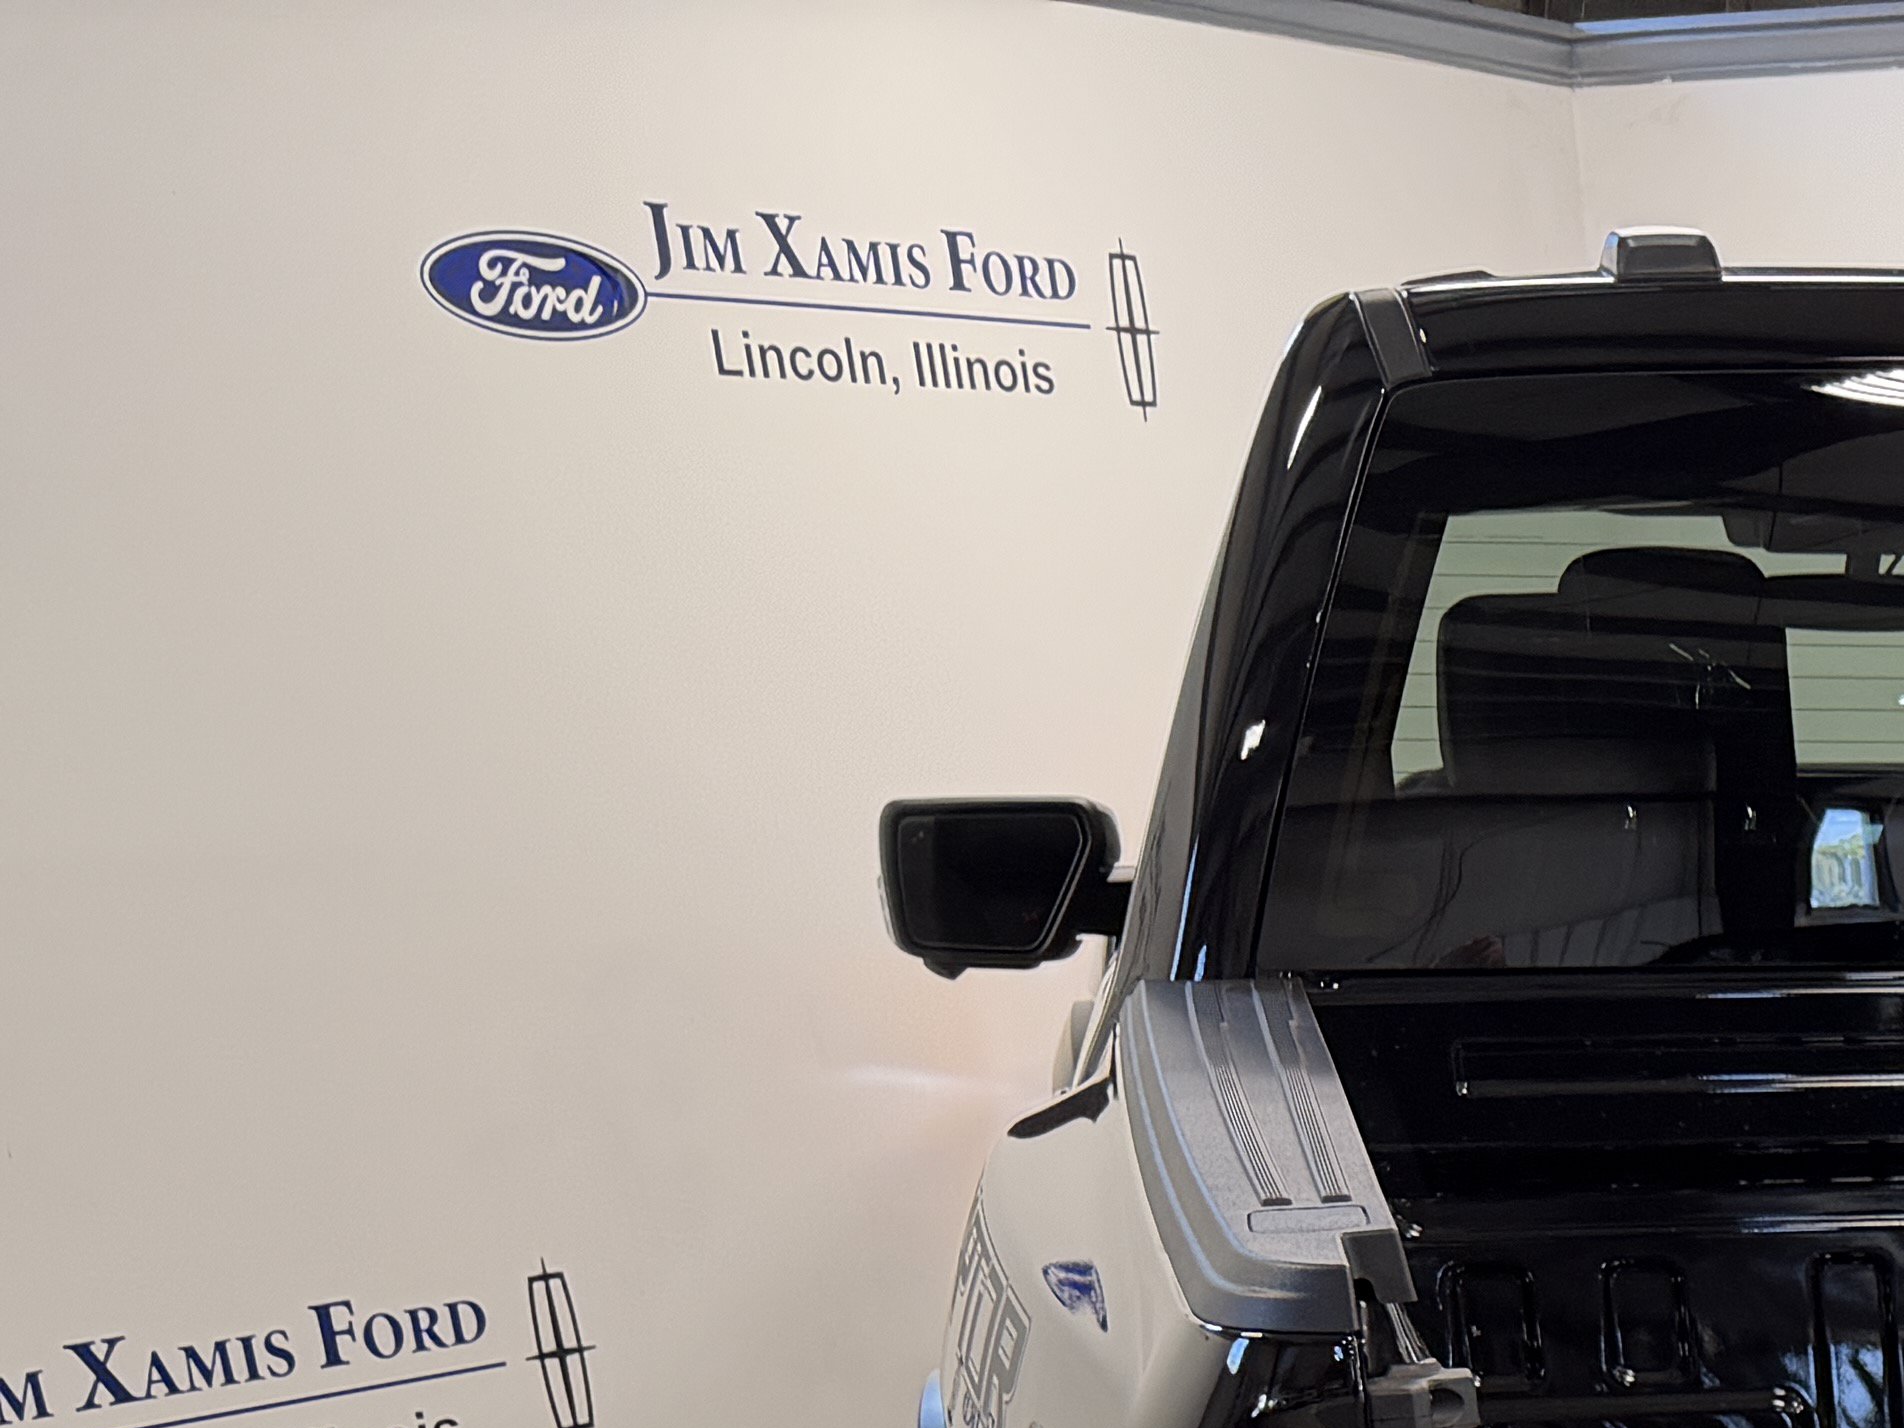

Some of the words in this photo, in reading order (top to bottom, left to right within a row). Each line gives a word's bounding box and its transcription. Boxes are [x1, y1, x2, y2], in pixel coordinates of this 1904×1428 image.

[469, 248, 603, 325] Ford
[710, 328, 901, 396] Lincoln,
[912, 340, 1056, 395] Illinois
